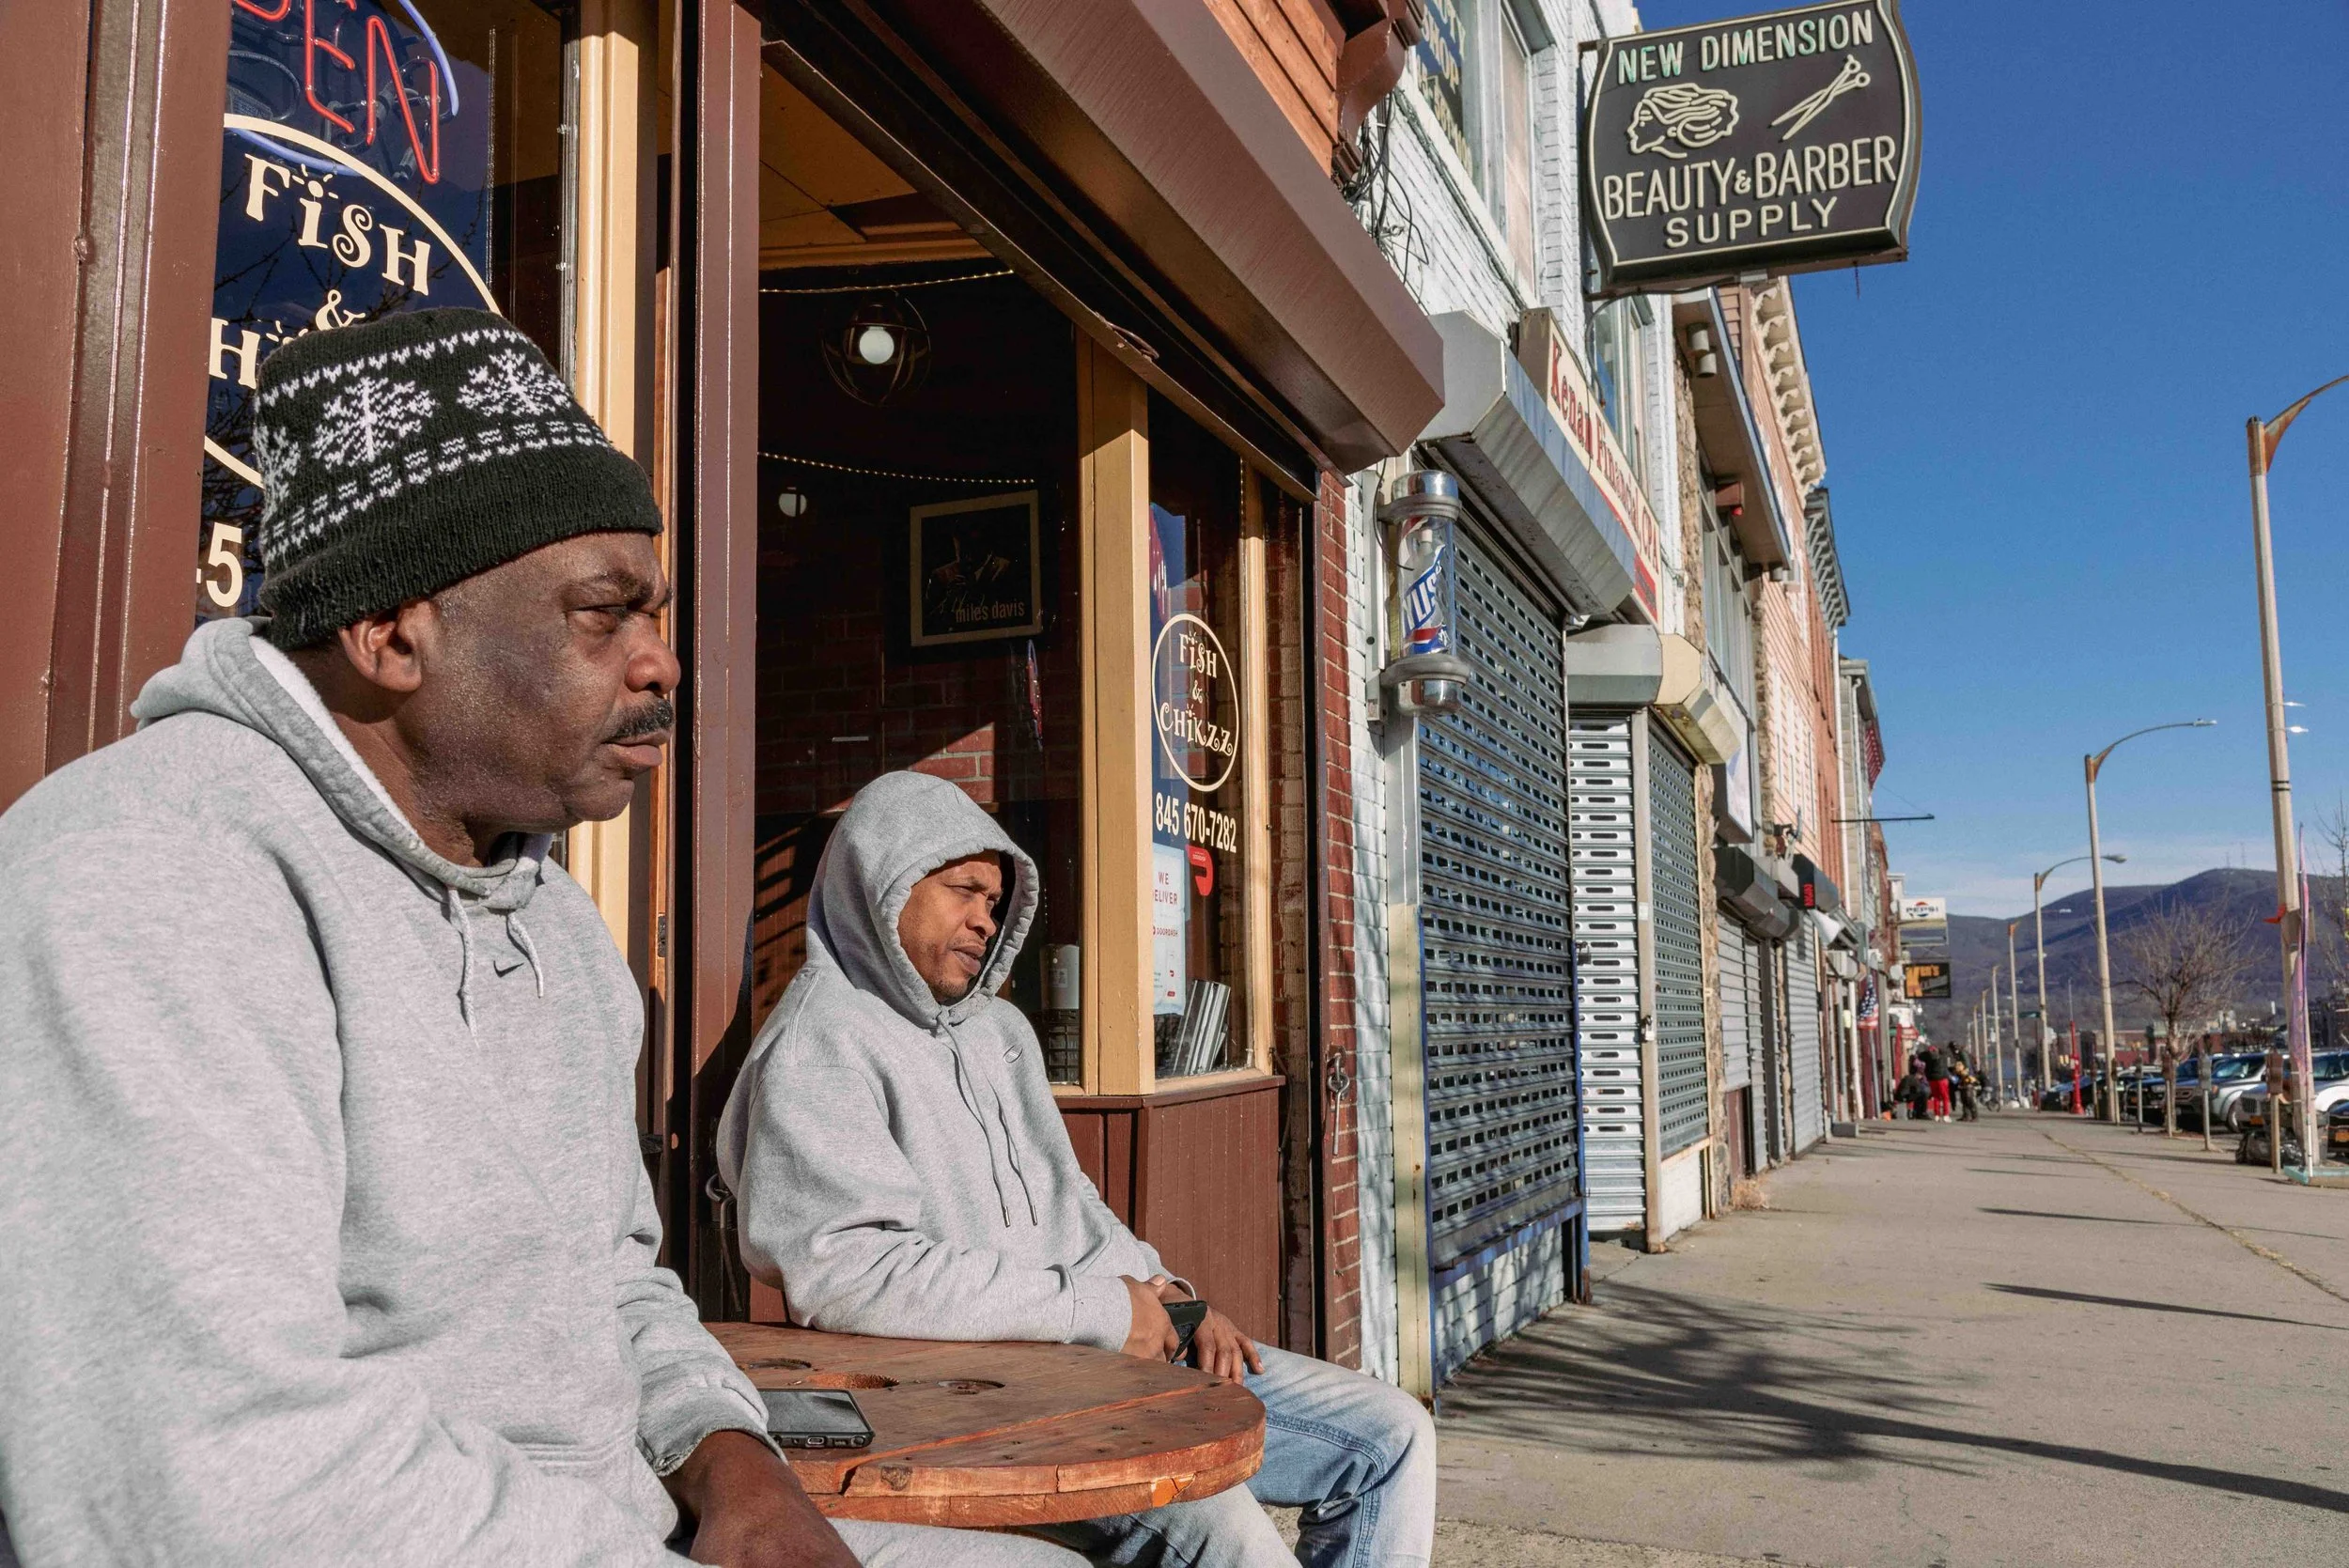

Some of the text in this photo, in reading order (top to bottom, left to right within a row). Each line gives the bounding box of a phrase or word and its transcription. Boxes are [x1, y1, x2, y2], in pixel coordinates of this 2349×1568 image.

[1618, 9, 1873, 85] NEW DIMENSION
[1603, 135, 1897, 221] BEAUTY & BARBER
[1665, 195, 1838, 249] SUPPLY
[317, 289, 366, 330] &
[1550, 334, 1594, 460] Kenan
[956, 599, 1025, 623] miles davis
[1192, 679, 1204, 704] &
[1155, 792, 1237, 854] 845 670-7282
[1153, 889, 1178, 905] ELIVER
[1158, 871, 1170, 885] WE
